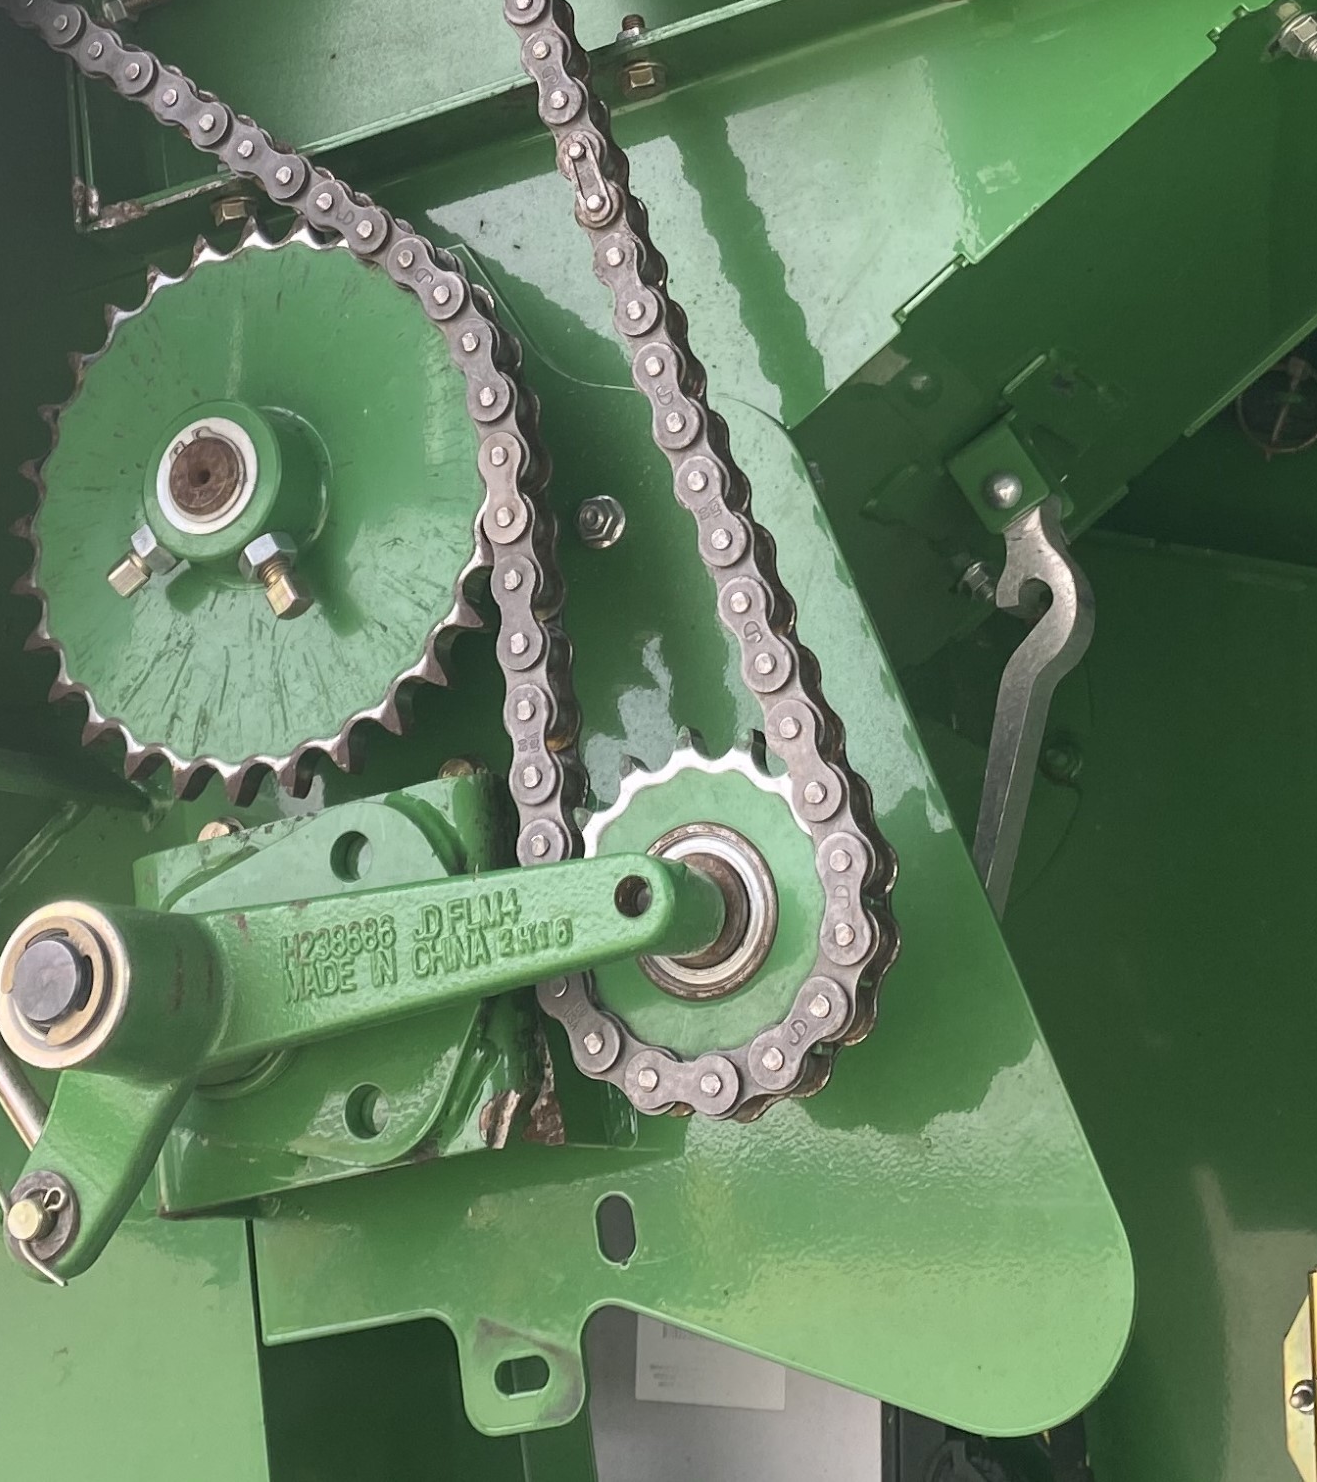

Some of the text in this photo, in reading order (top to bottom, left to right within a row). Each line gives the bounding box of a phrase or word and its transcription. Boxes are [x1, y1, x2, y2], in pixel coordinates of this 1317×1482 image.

[283, 931, 492, 1003] MADE IN CHINA
